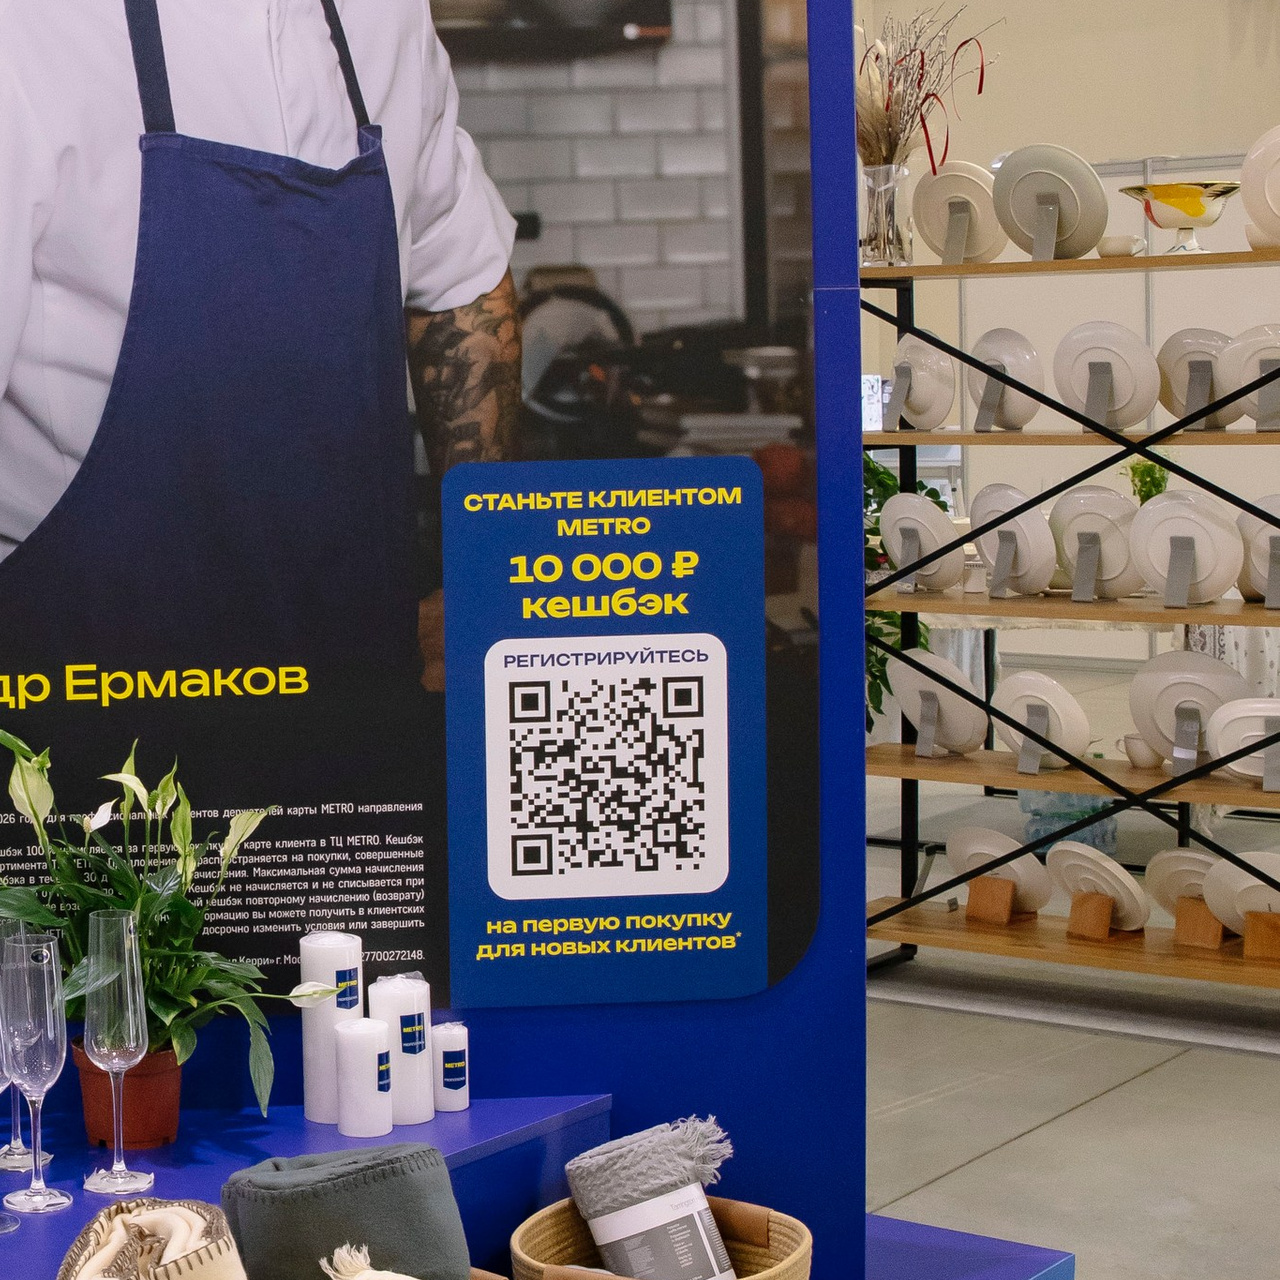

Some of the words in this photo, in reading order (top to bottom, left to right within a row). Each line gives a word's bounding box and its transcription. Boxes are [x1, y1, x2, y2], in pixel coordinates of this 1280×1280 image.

[464, 490, 583, 512] СТАНЬТЕ
[588, 486, 742, 508] КЛИЕНТОМ
[557, 516, 651, 537] METRO
[509, 554, 562, 584] 10
[572, 551, 663, 582] 000
[522, 588, 689, 619] кешбэк
[503, 648, 709, 669] РЕГИСТРИРУЙТЕСЬ
[65, 664, 309, 708] Ермаков
[287, 806, 317, 818] карты
[321, 802, 354, 814] METRO
[358, 803, 423, 816] направления
[26, 844, 44, 856] 100
[244, 840, 272, 852] карте
[275, 839, 316, 849] клиента
[320, 838, 326, 847] в
[330, 836, 343, 848] ТЦ
[347, 834, 382, 846] METRO.
[386, 833, 424, 845] Кешбэк
[292, 853, 304, 862] на
[307, 852, 352, 864] покупки,
[355, 850, 424, 863] совершенные
[29, 875, 35, 884] в
[84, 871, 97, 882] 30
[253, 864, 325, 877] Максимальная
[329, 866, 362, 877] сумма
[365, 864, 424, 874] начисления
[230, 883, 242, 892] не
[246, 881, 309, 891] начисляется
[312, 881, 319, 889] и
[322, 880, 335, 889] не
[338, 878, 402, 889] списывается
[406, 877, 425, 889] при
[246, 895, 306, 908] повторному
[309, 893, 370, 903] начислению
[373, 889, 425, 904] (возврату)
[252, 910, 266, 919] вы
[269, 909, 306, 919] можете
[309, 907, 356, 920] получить
[358, 907, 365, 916] в
[367, 905, 425, 916] клиентских
[202, 924, 250, 937] досрочно
[253, 923, 302, 933] изменить
[305, 921, 345, 934] условия
[349, 921, 368, 930] или
[370, 919, 425, 932] завершить
[487, 919, 518, 935] на
[522, 914, 620, 936] первую
[626, 910, 733, 934] покупку
[360, 950, 426, 962] 27700272148.
[476, 941, 525, 960] для
[531, 939, 611, 956] новых
[403, 1025, 424, 1033] METRO
[444, 1061, 466, 1069] METRO
